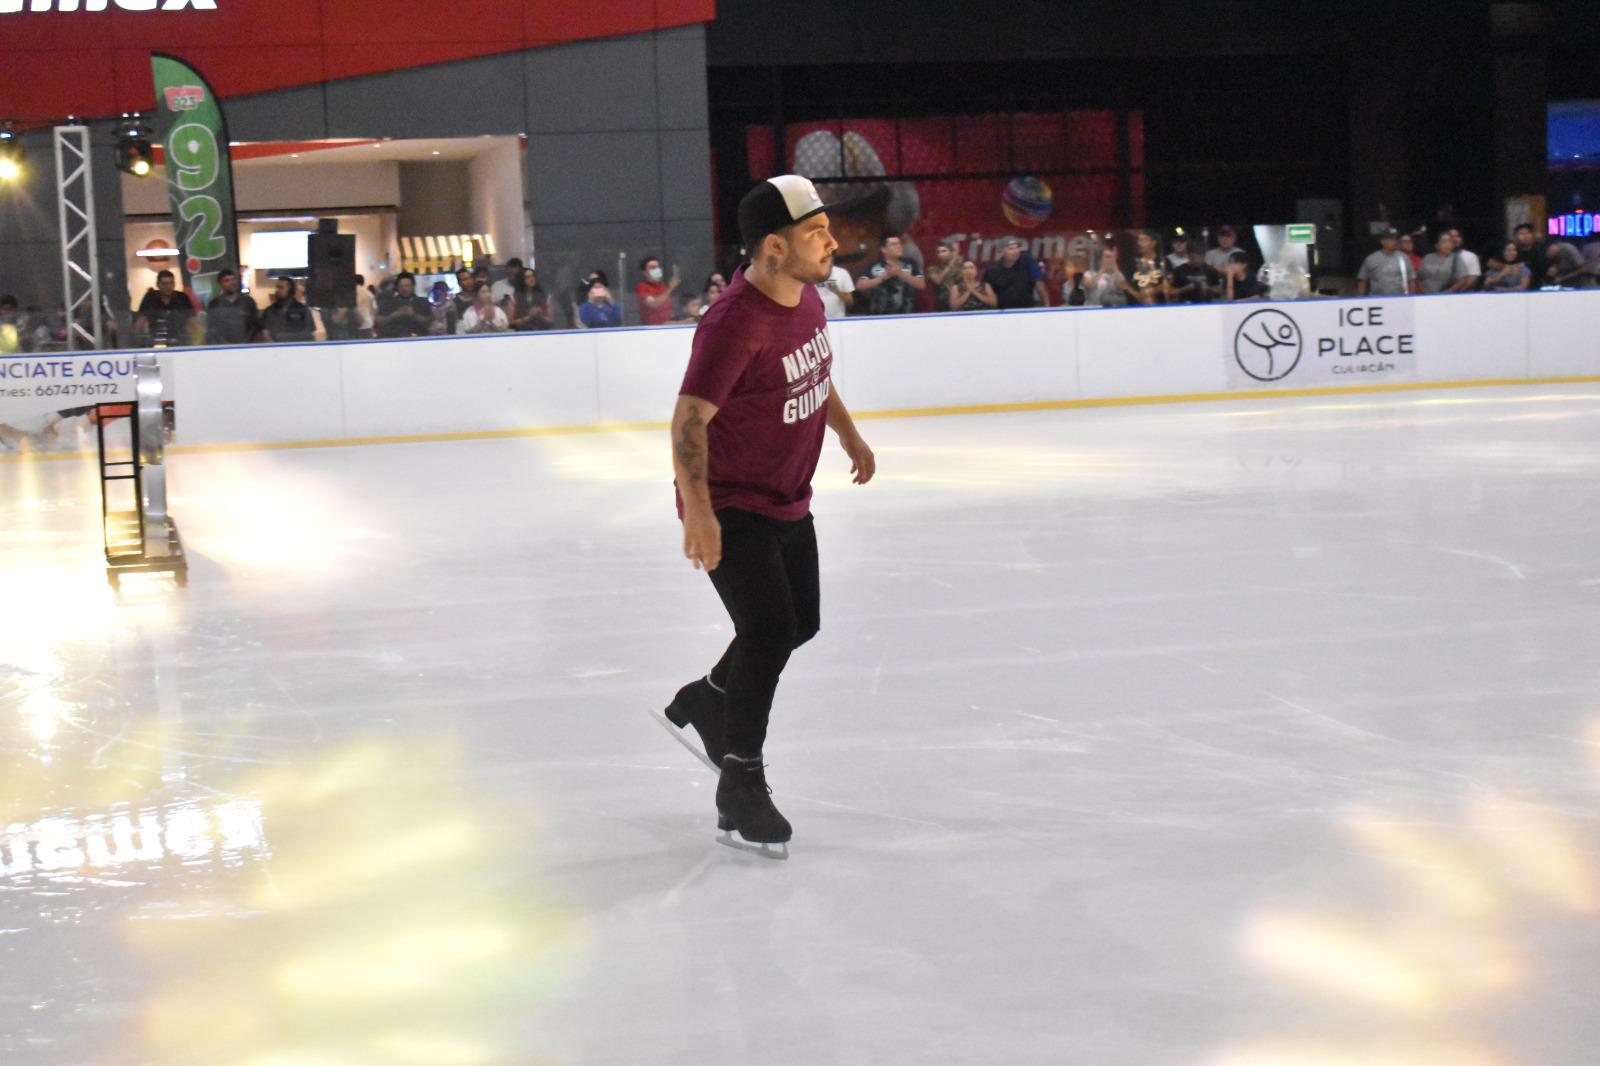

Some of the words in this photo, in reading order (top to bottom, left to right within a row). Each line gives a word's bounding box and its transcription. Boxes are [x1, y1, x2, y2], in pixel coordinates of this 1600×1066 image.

[1338, 306, 1383, 327] ICE
[1318, 334, 1413, 357] PLACE
[35, 384, 118, 397] 6674716172
